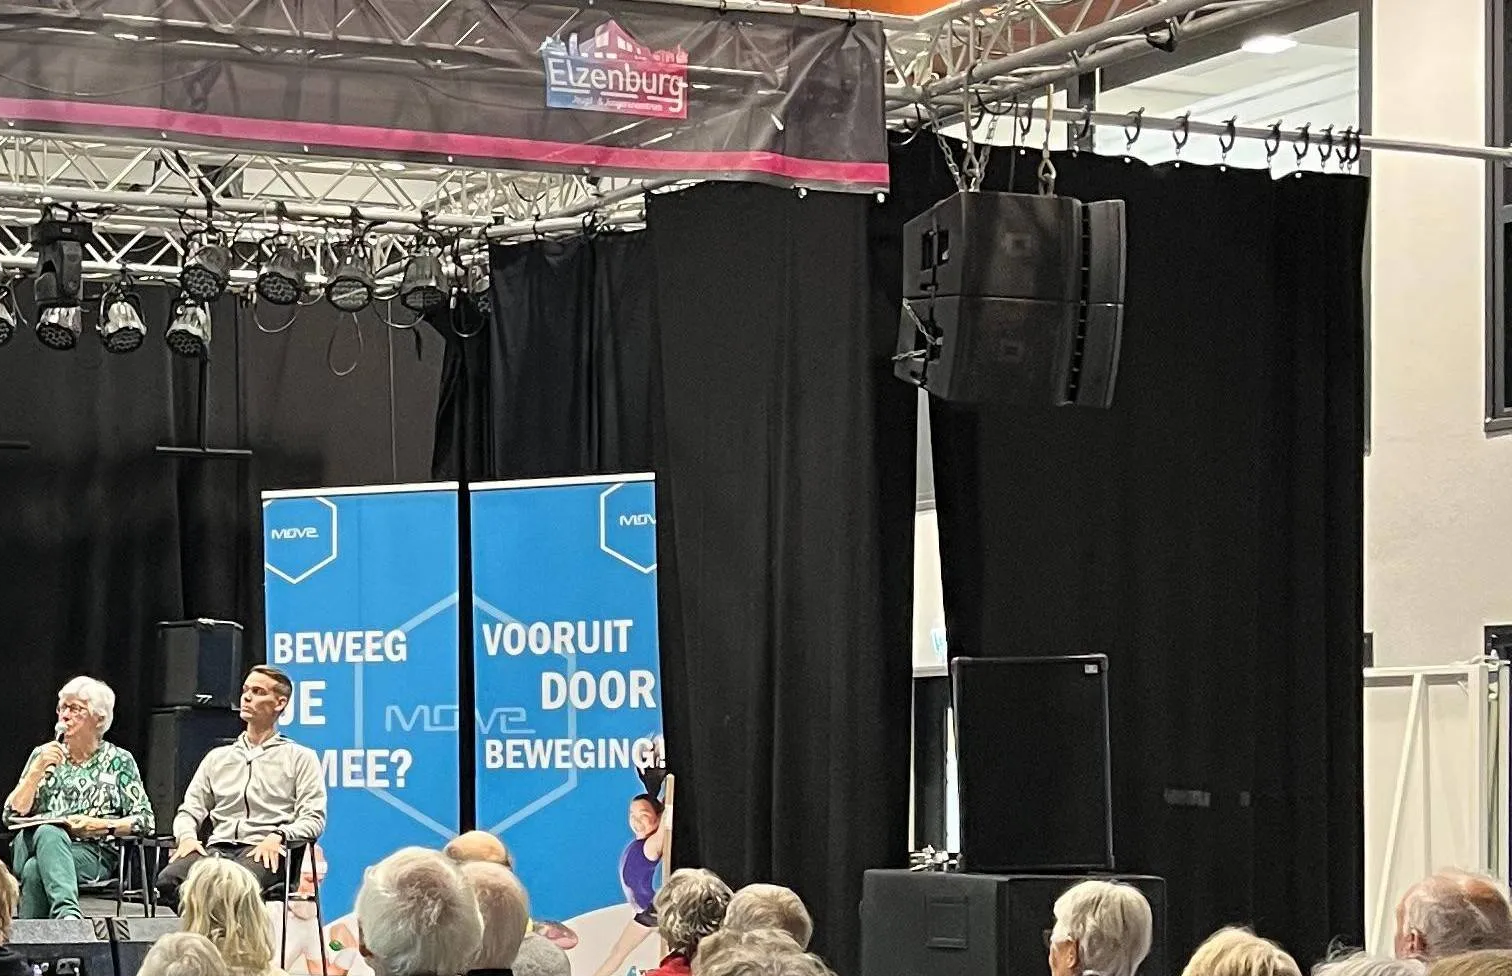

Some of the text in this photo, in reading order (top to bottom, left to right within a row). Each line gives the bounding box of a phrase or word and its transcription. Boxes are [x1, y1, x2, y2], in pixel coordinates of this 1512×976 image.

[548, 57, 684, 112] Elzenburg
[273, 629, 408, 664] BEWEEG
[482, 619, 633, 656] VOORUIT
[277, 680, 327, 727] JE
[541, 670, 656, 711] DOOR
[486, 738, 667, 770] BEWEGING!
